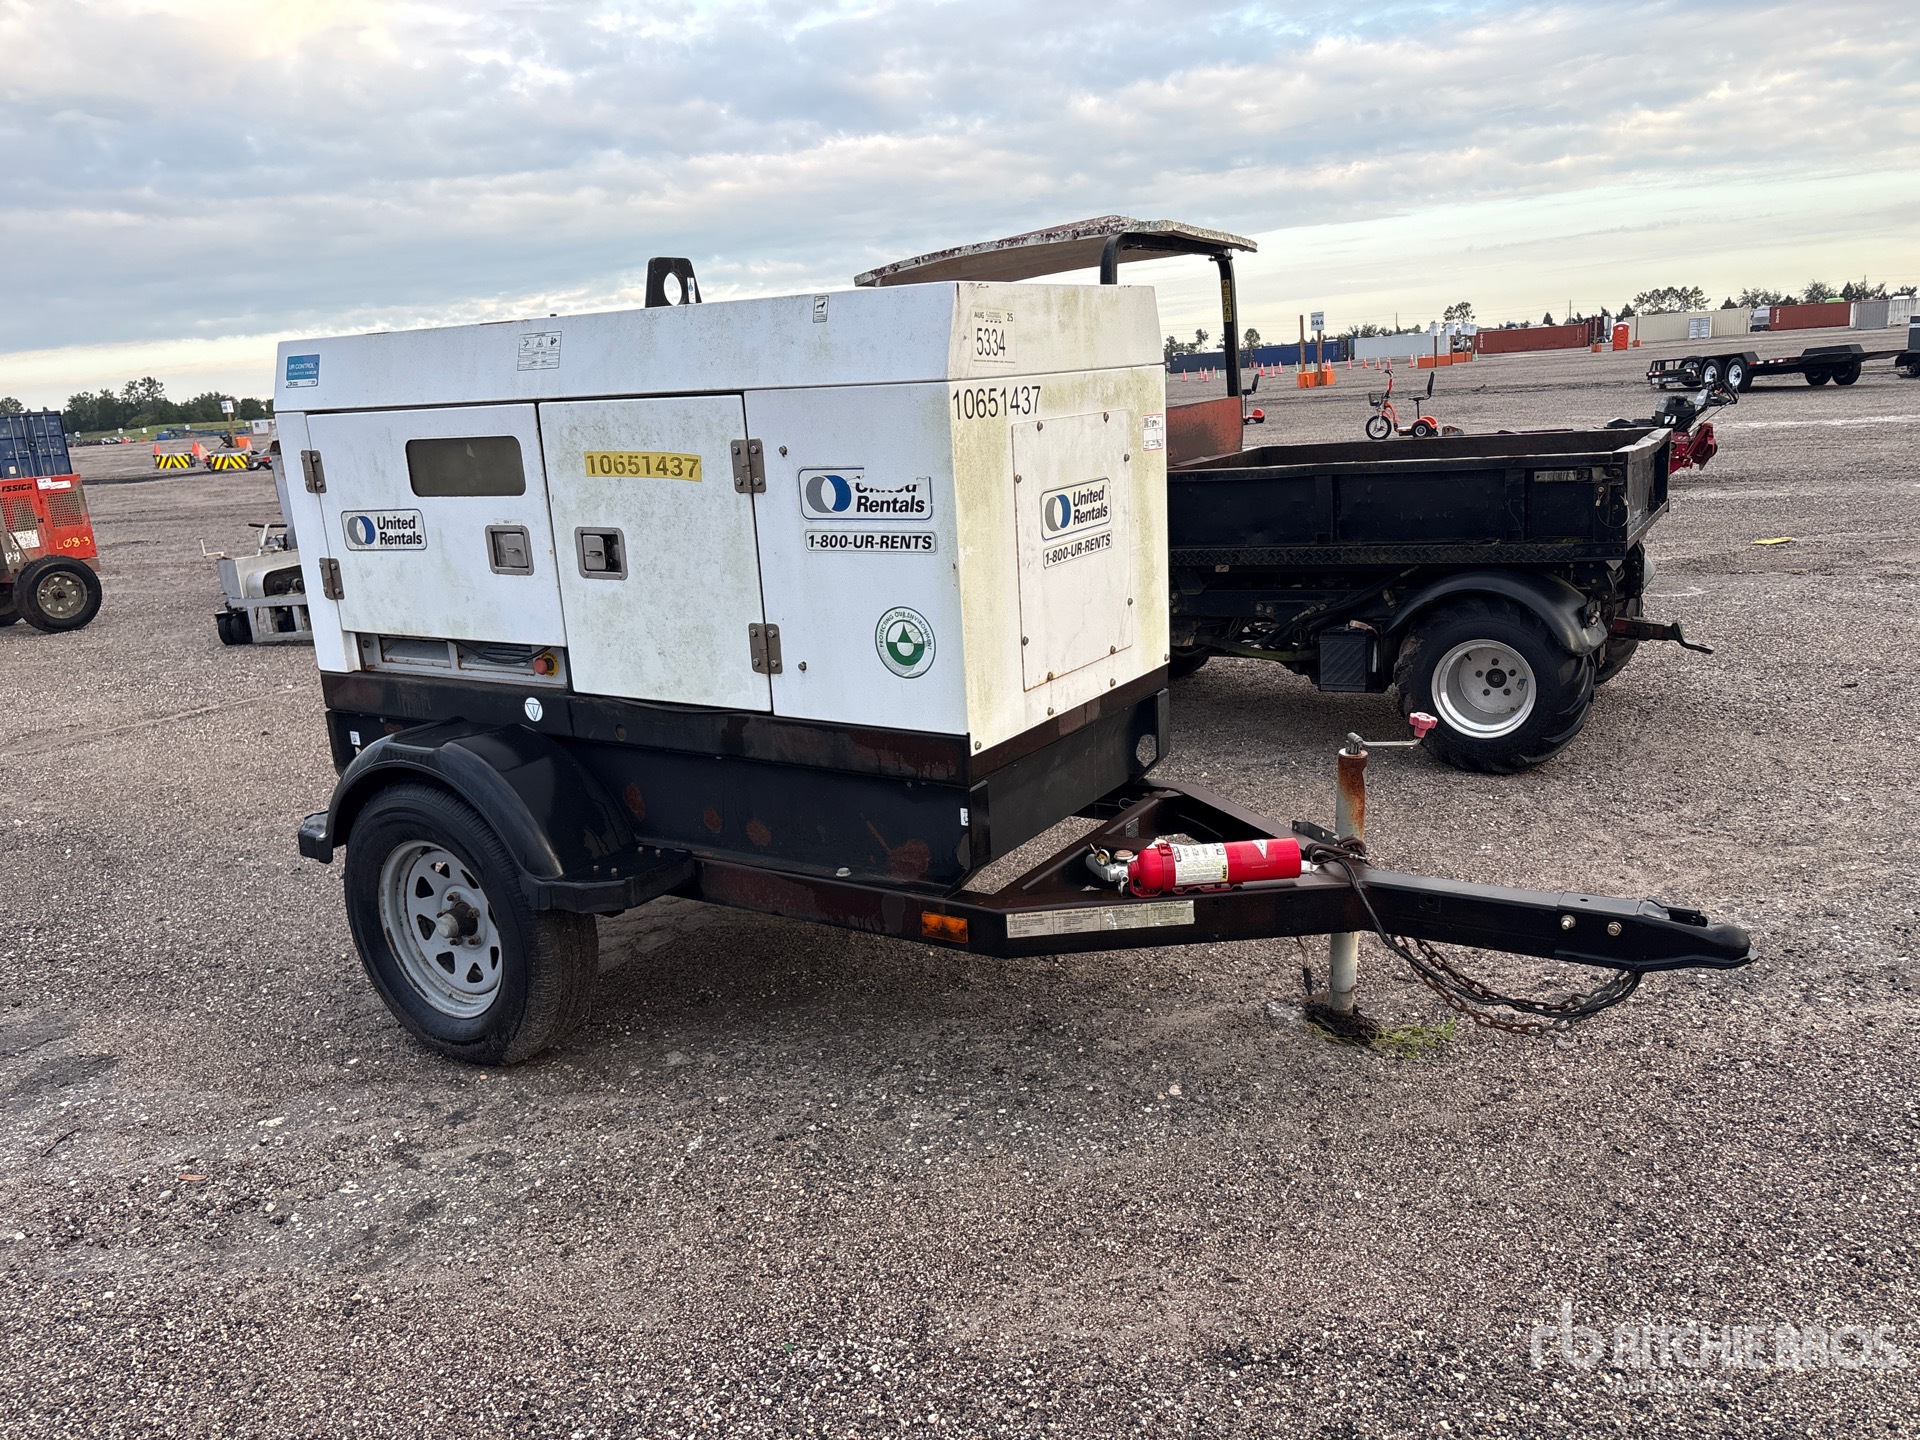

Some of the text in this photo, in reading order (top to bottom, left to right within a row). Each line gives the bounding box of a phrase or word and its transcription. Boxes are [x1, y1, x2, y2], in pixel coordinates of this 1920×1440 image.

[974, 311, 985, 319] AUG
[1006, 312, 1014, 322] 25
[976, 327, 1006, 357] 5334
[952, 386, 1041, 420] 10651437
[586, 453, 700, 480] 10651437
[856, 495, 925, 513] Rentals
[1073, 485, 1105, 507] United
[377, 515, 416, 530] United
[1073, 502, 1108, 526] Rentals
[379, 529, 423, 546] Rentals
[808, 533, 933, 550] 1-800-UR-RENTS
[1045, 533, 1111, 565] 1-800-UR-RENTS
[879, 614, 895, 648] PROTECTING
[905, 612, 932, 651] ENVIRONMENT
